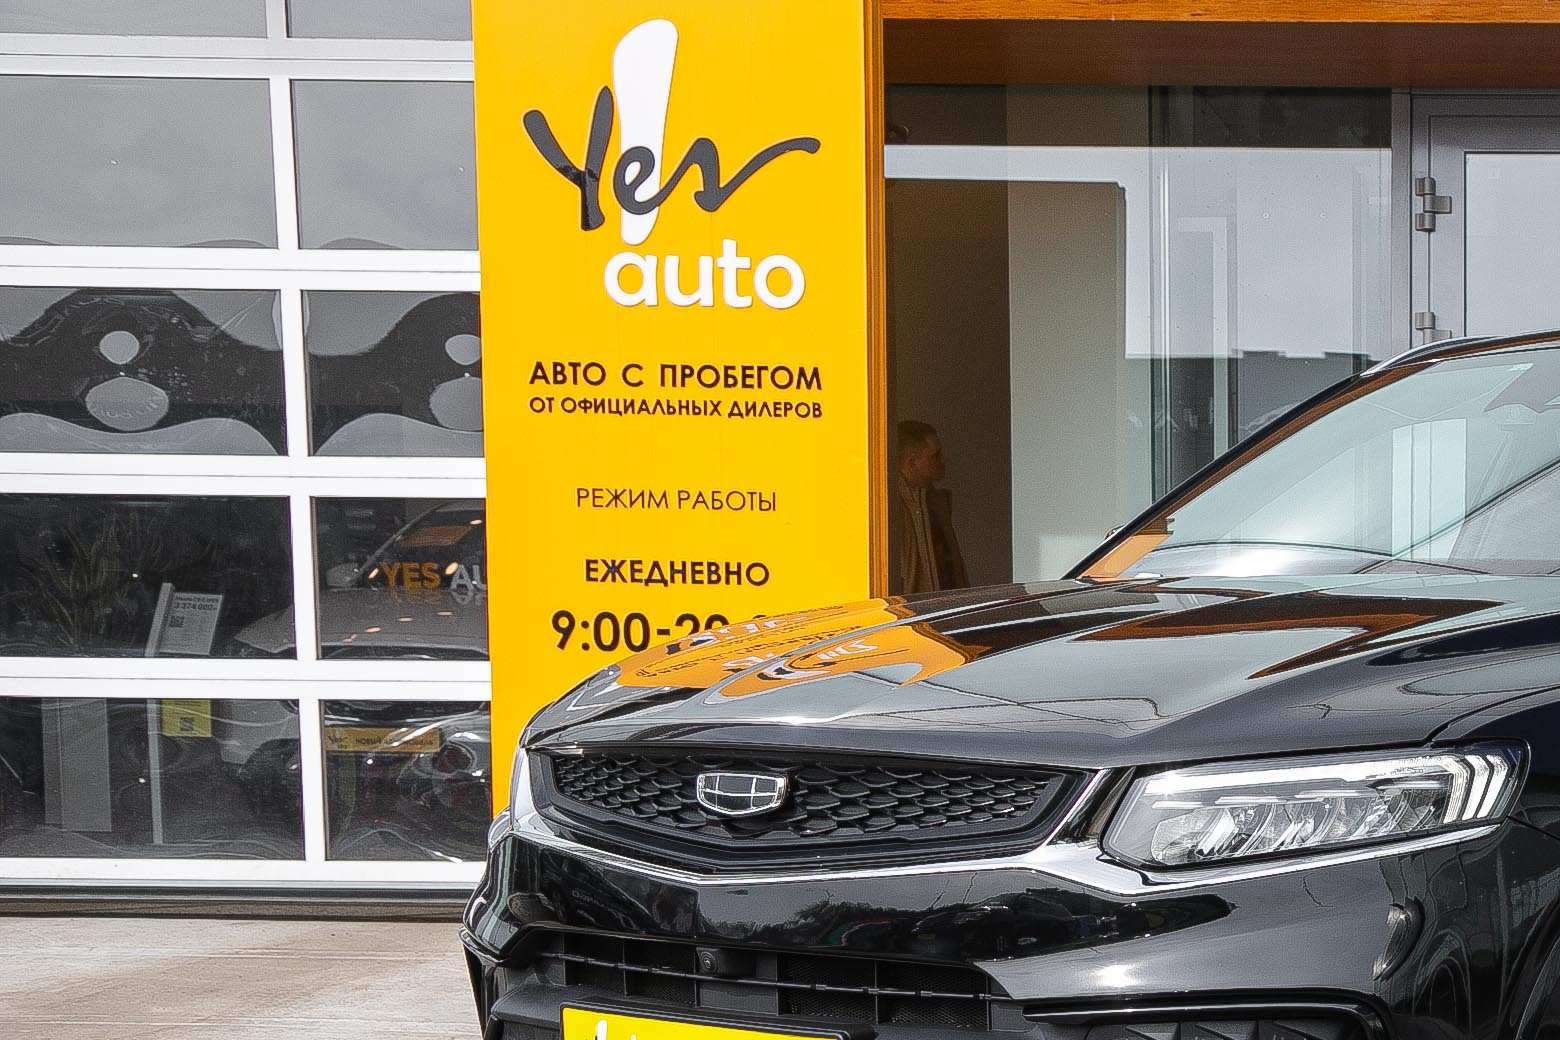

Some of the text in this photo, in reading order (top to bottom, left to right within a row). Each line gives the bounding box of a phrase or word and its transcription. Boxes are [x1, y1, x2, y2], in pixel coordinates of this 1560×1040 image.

[523, 86, 821, 231] Yes
[604, 238, 806, 310] auto
[529, 361, 822, 390] АВТО С ПРОБЕГОМ
[529, 397, 823, 419] ОТ ОФИЦИАЛЬНЫХ ДИЛЕРОВ
[576, 487, 777, 512] РЕЖИМ РАБОТЫ
[380, 562, 441, 589] YES
[585, 559, 770, 588] ЕЖЕДНЕВНО
[551, 610, 767, 652] 9:00-2
